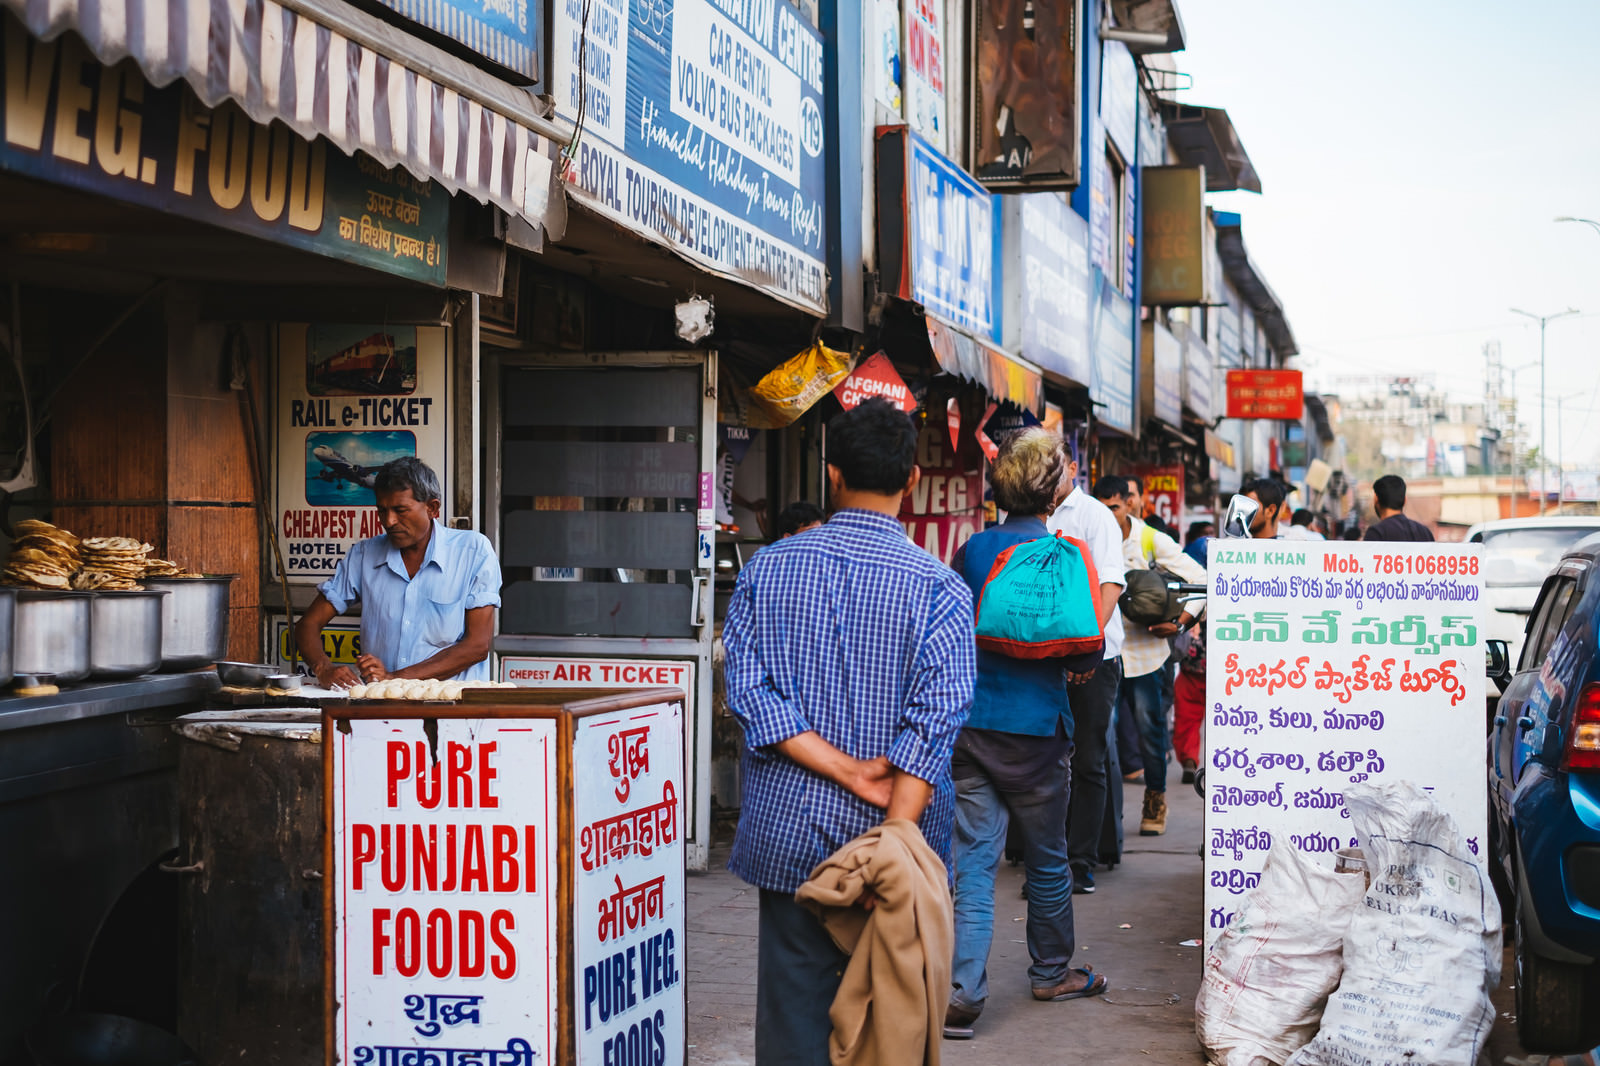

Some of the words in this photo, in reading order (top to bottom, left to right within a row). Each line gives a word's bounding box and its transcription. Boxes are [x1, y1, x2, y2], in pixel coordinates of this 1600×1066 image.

[591, 0, 619, 50] JAIPUR
[778, 5, 824, 95] CENTRE
[571, 29, 612, 88] HRIDWAR
[709, 22, 732, 78] CAR
[734, 41, 773, 107] RENTAL
[570, 72, 611, 130] RIHIKESH
[677, 55, 716, 122] VOLVO
[720, 85, 741, 138] BUS
[744, 102, 793, 172] PACKAGES
[3, 28, 158, 185] VEG.
[173, 78, 327, 232] FOOD
[801, 101, 820, 152] 119
[641, 96, 706, 171] Himachal
[708, 139, 761, 215] Holidays
[761, 171, 790, 221] Tours
[366, 189, 394, 219] ऊपर
[395, 193, 421, 227] बैठने
[581, 141, 622, 213] ROYAL
[626, 167, 677, 240] TOURISM
[680, 197, 753, 271] DEVELOPMENT
[754, 235, 787, 288] CENTRE
[339, 215, 358, 242] का
[360, 214, 392, 251] विशेष
[394, 233, 425, 261] प्रबन्ध
[292, 399, 336, 427] RAIL
[342, 398, 433, 427] e-TICKET
[844, 376, 907, 400] AFGHANI
[727, 427, 750, 441] TIKKA
[701, 475, 709, 507] PUSH
[912, 475, 975, 516] VEG.
[283, 510, 356, 539] CHEAPEST
[360, 510, 384, 539] AIR
[289, 543, 346, 556] HOTEL
[1215, 551, 1257, 565] AZAM
[1264, 552, 1306, 566] KHAN
[1323, 553, 1364, 574] Mob.
[1373, 555, 1479, 576] 7861068958
[1215, 572, 1228, 597] మీ
[1230, 574, 1288, 603] ప్రయాణము
[1290, 575, 1323, 599] కొరకు
[1325, 577, 1343, 599] మా
[1345, 578, 1363, 610] వద్ద
[1366, 579, 1408, 603] లభించు
[1411, 578, 1479, 602] వాహనములు
[1215, 611, 1289, 643] వన్
[1302, 610, 1342, 644] వే
[1352, 615, 1478, 656] సర్వీస్
[509, 669, 551, 681] CHEPEST
[553, 664, 593, 683] AIR
[600, 665, 684, 685] TICKET
[1314, 654, 1396, 704] ప్యాకేజ్
[1213, 702, 1264, 735] సిమ్లా,
[1269, 706, 1318, 733] కులు,
[1323, 707, 1385, 731] మనాలి
[387, 741, 499, 810] PURE
[607, 725, 651, 804] शुद्ध
[1212, 747, 1311, 778] ధర్మశాల,
[1212, 782, 1288, 813] నైనితాల్,
[580, 779, 678, 871] शाकाहारी
[352, 824, 537, 893] PUNJABI
[597, 873, 666, 942] भोजन
[372, 907, 517, 980] FOODS
[584, 945, 637, 1031] PURE
[640, 928, 680, 1000] VEG.
[403, 993, 485, 1037] शुद्ध
